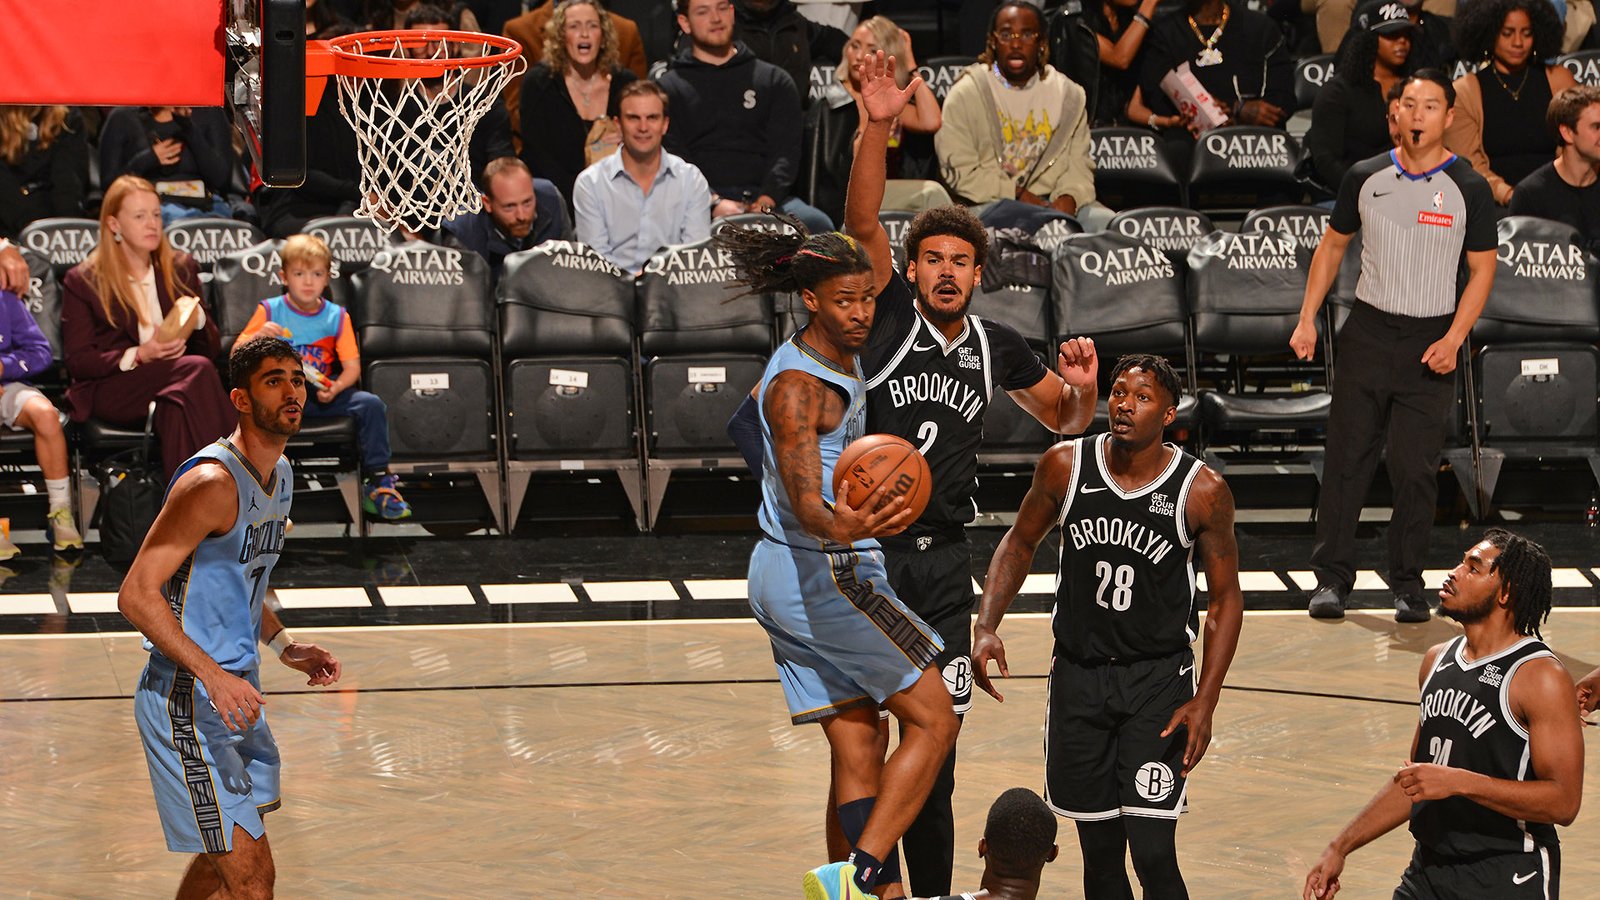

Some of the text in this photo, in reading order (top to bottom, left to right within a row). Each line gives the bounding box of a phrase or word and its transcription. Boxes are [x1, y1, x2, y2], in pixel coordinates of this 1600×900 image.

[918, 66, 963, 89] QAT
[743, 89, 757, 110] S
[1206, 134, 1288, 159] QATAR
[1097, 155, 1158, 170] AIRWAYS
[1228, 153, 1289, 168] AIRWAYS
[1119, 216, 1202, 239] QATAR
[1419, 213, 1452, 226] Emirates
[27, 229, 100, 254] QATA
[169, 228, 254, 253] QATAR
[1205, 235, 1296, 260] QATAR
[370, 250, 464, 274] QATAR
[645, 248, 736, 277] QATAR
[1081, 246, 1171, 278] QATAR
[1227, 255, 1298, 270] AIRWAYS
[1496, 240, 1586, 267] QATAR
[552, 253, 622, 278] AIRWAYS
[668, 267, 737, 286] AIRWAYS
[1105, 264, 1175, 287] AIRWAYS
[1514, 263, 1586, 281] AIRWAYS
[392, 270, 464, 286] AIRWAYS
[958, 347, 973, 355] GET
[959, 353, 980, 363] YOUR
[959, 360, 982, 370] GUIDE
[888, 372, 984, 424] BROOKLYN
[917, 420, 939, 456] 2
[1151, 492, 1169, 502] GET
[1151, 498, 1175, 510] YOUR
[1148, 505, 1175, 517] GUIDE
[1069, 516, 1174, 565] BROOKLYN
[249, 565, 267, 609] 7
[1095, 560, 1135, 612] 28
[955, 661, 967, 692] B
[1478, 675, 1501, 689] GUIDE
[1147, 767, 1161, 796] B
